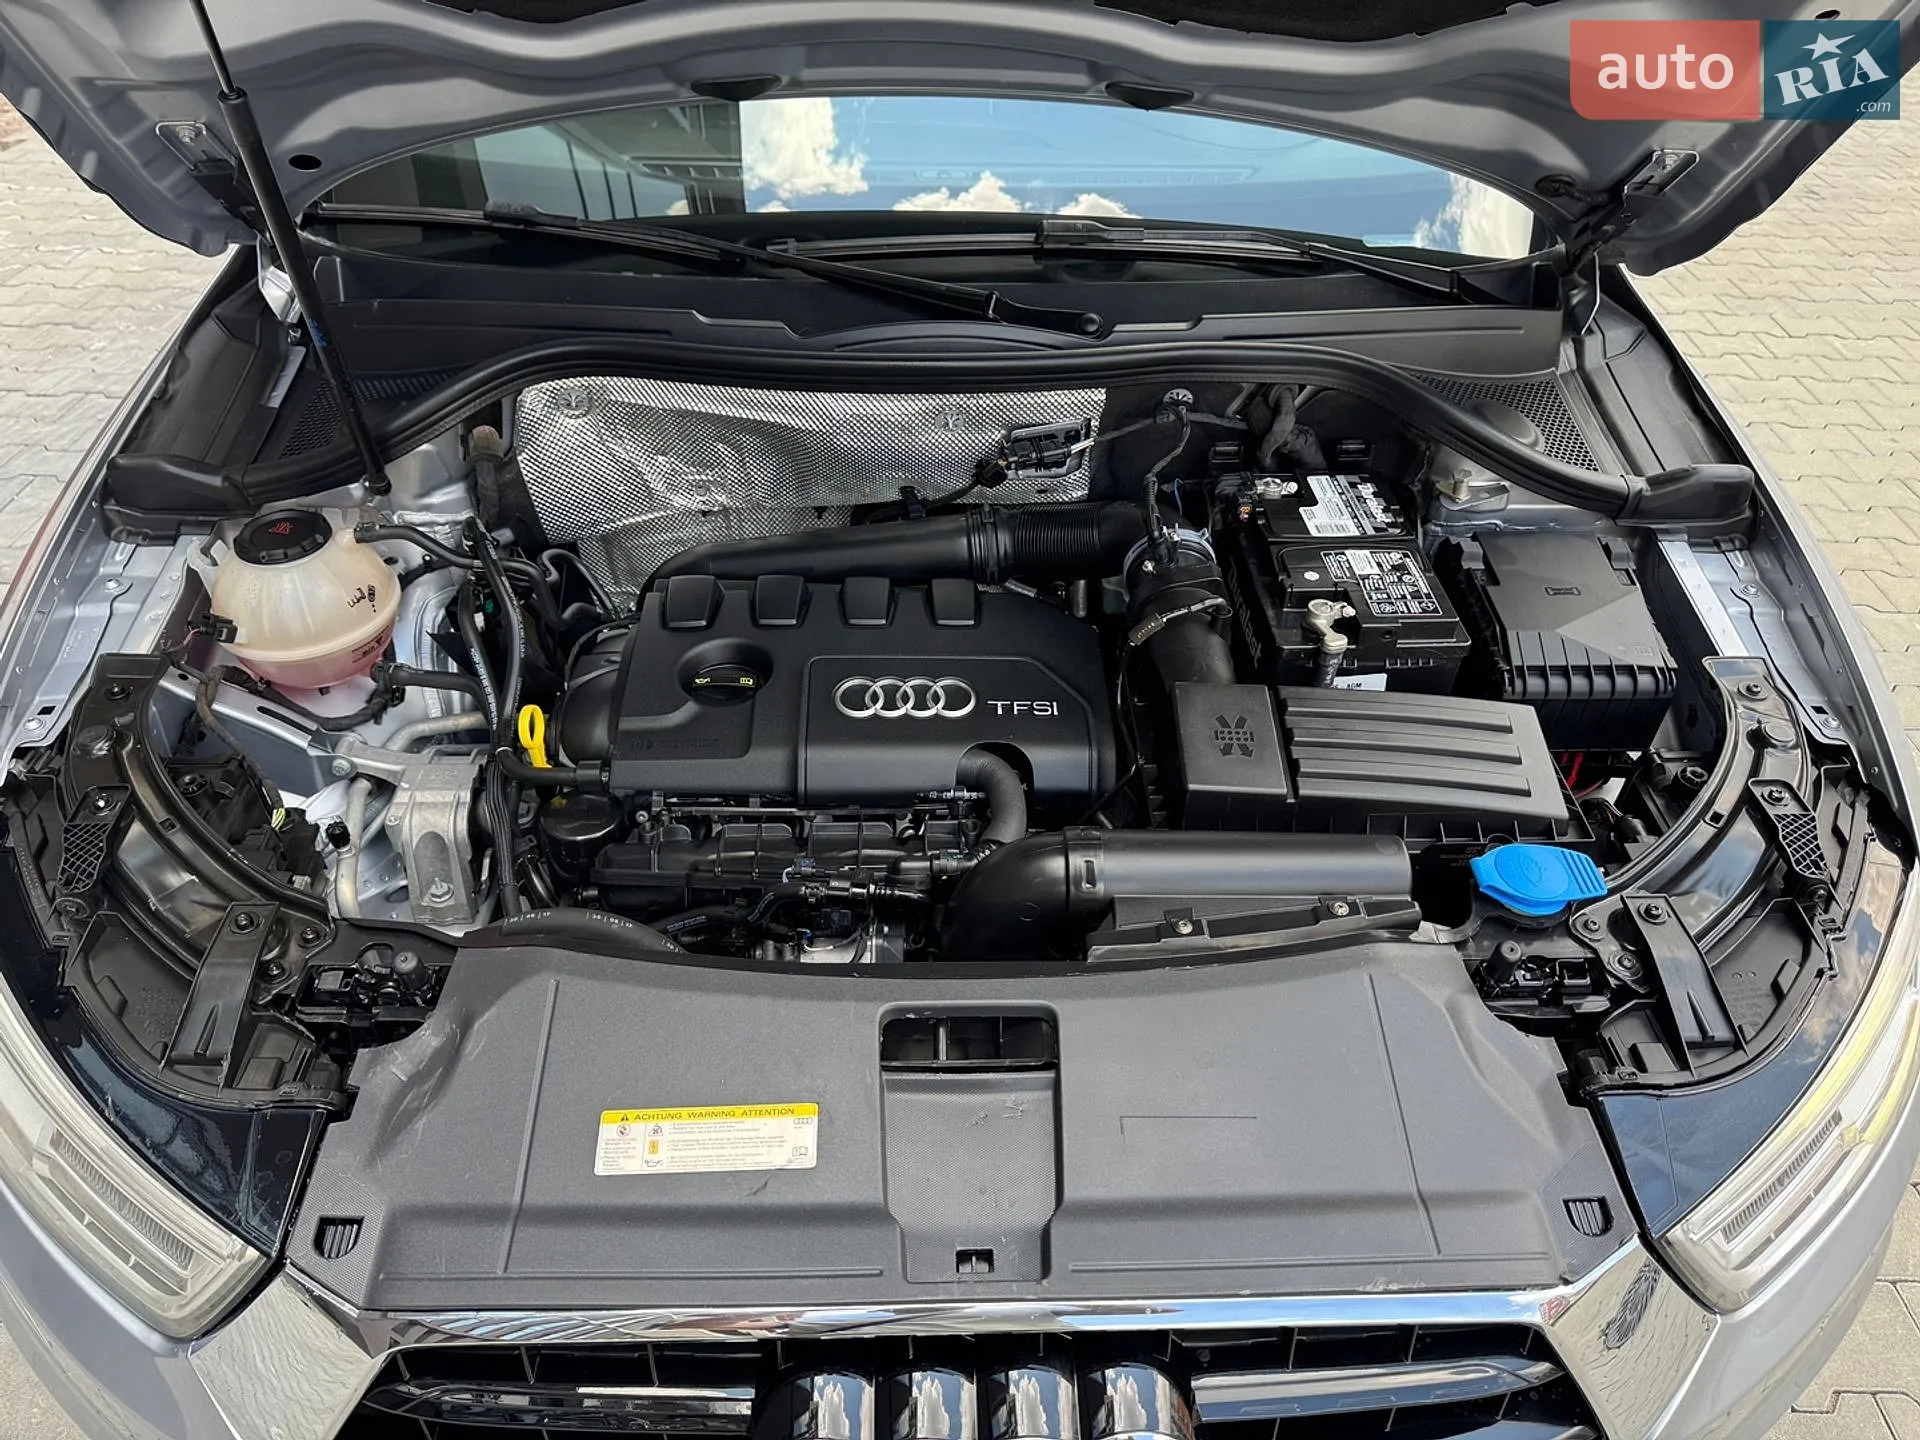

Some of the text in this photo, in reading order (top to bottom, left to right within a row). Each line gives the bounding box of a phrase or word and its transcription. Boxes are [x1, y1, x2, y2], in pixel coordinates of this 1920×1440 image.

[987, 701, 1058, 715] TFSI
[634, 1107, 795, 1121] ACHTUNG WARNING ATTENTION
